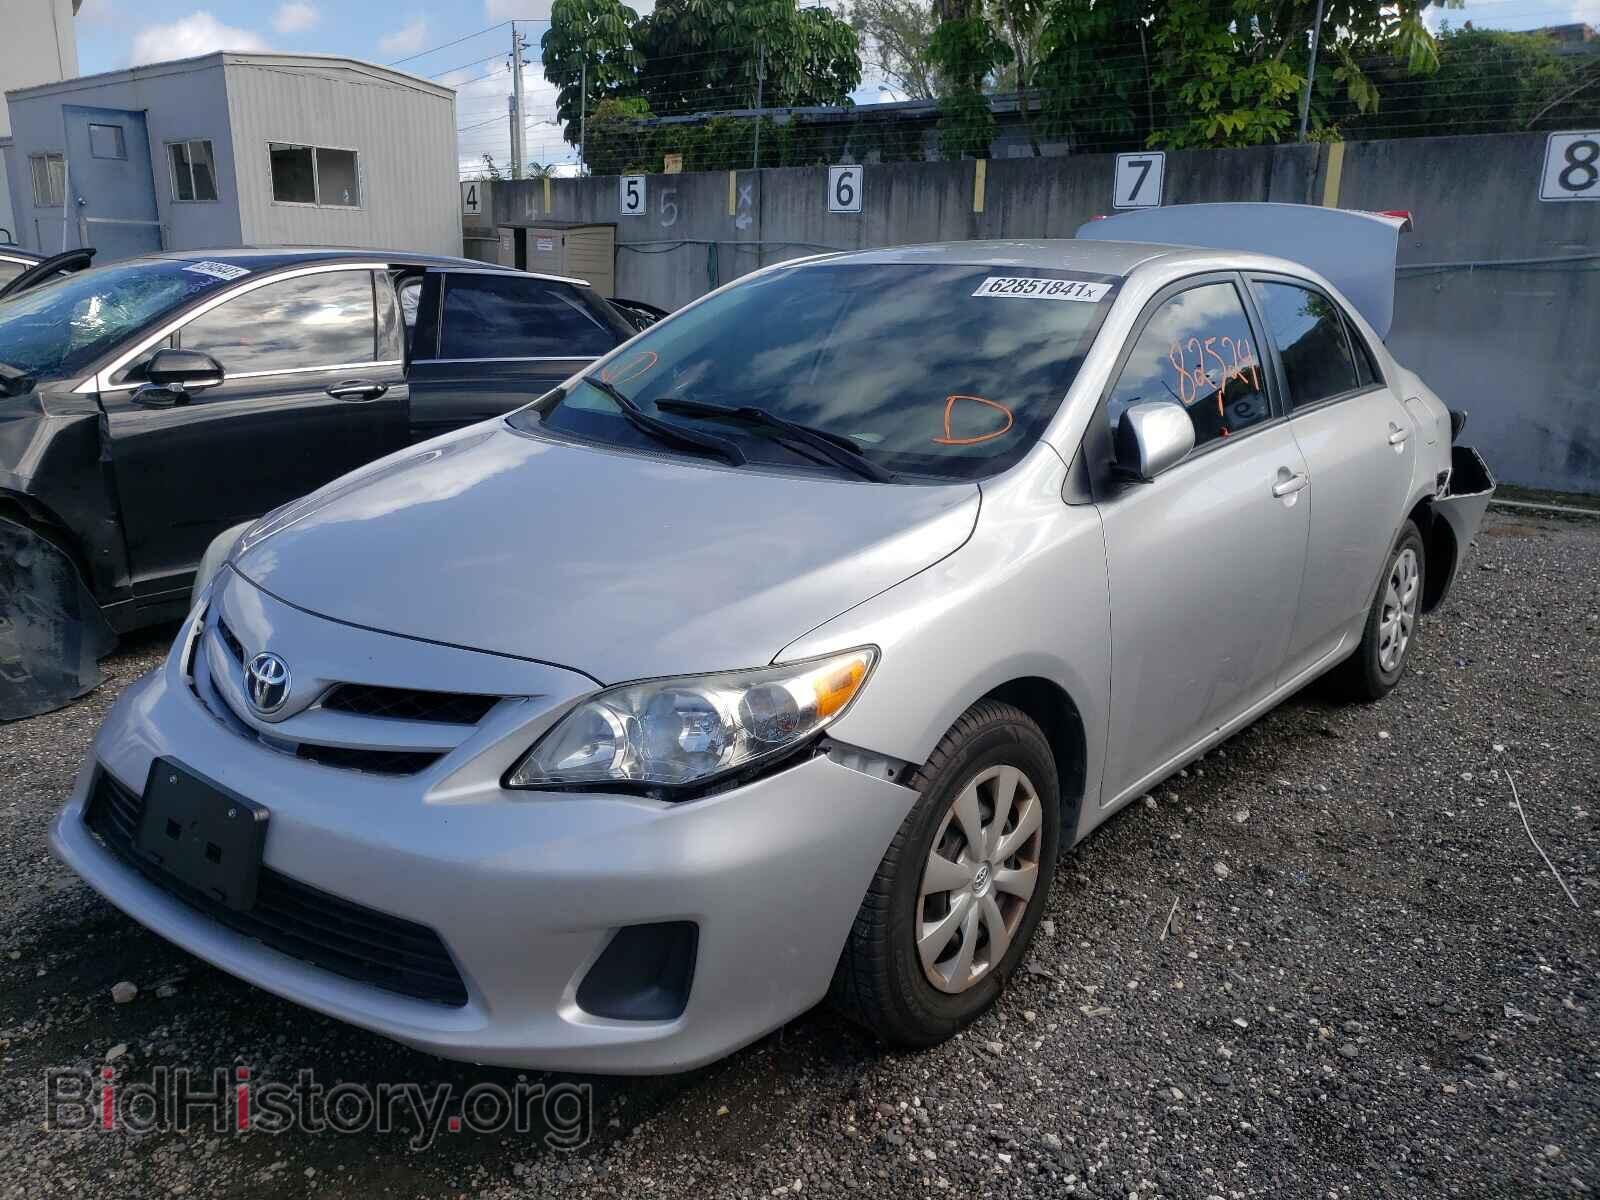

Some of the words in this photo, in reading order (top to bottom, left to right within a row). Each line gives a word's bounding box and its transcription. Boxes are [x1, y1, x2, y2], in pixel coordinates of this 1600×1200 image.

[1127, 160, 1153, 201] 7
[1558, 140, 1600, 191] 8
[466, 185, 477, 210] 4
[627, 180, 639, 209] 5
[660, 187, 678, 227] 5
[836, 172, 853, 206] 6
[929, 395, 1014, 444] D
